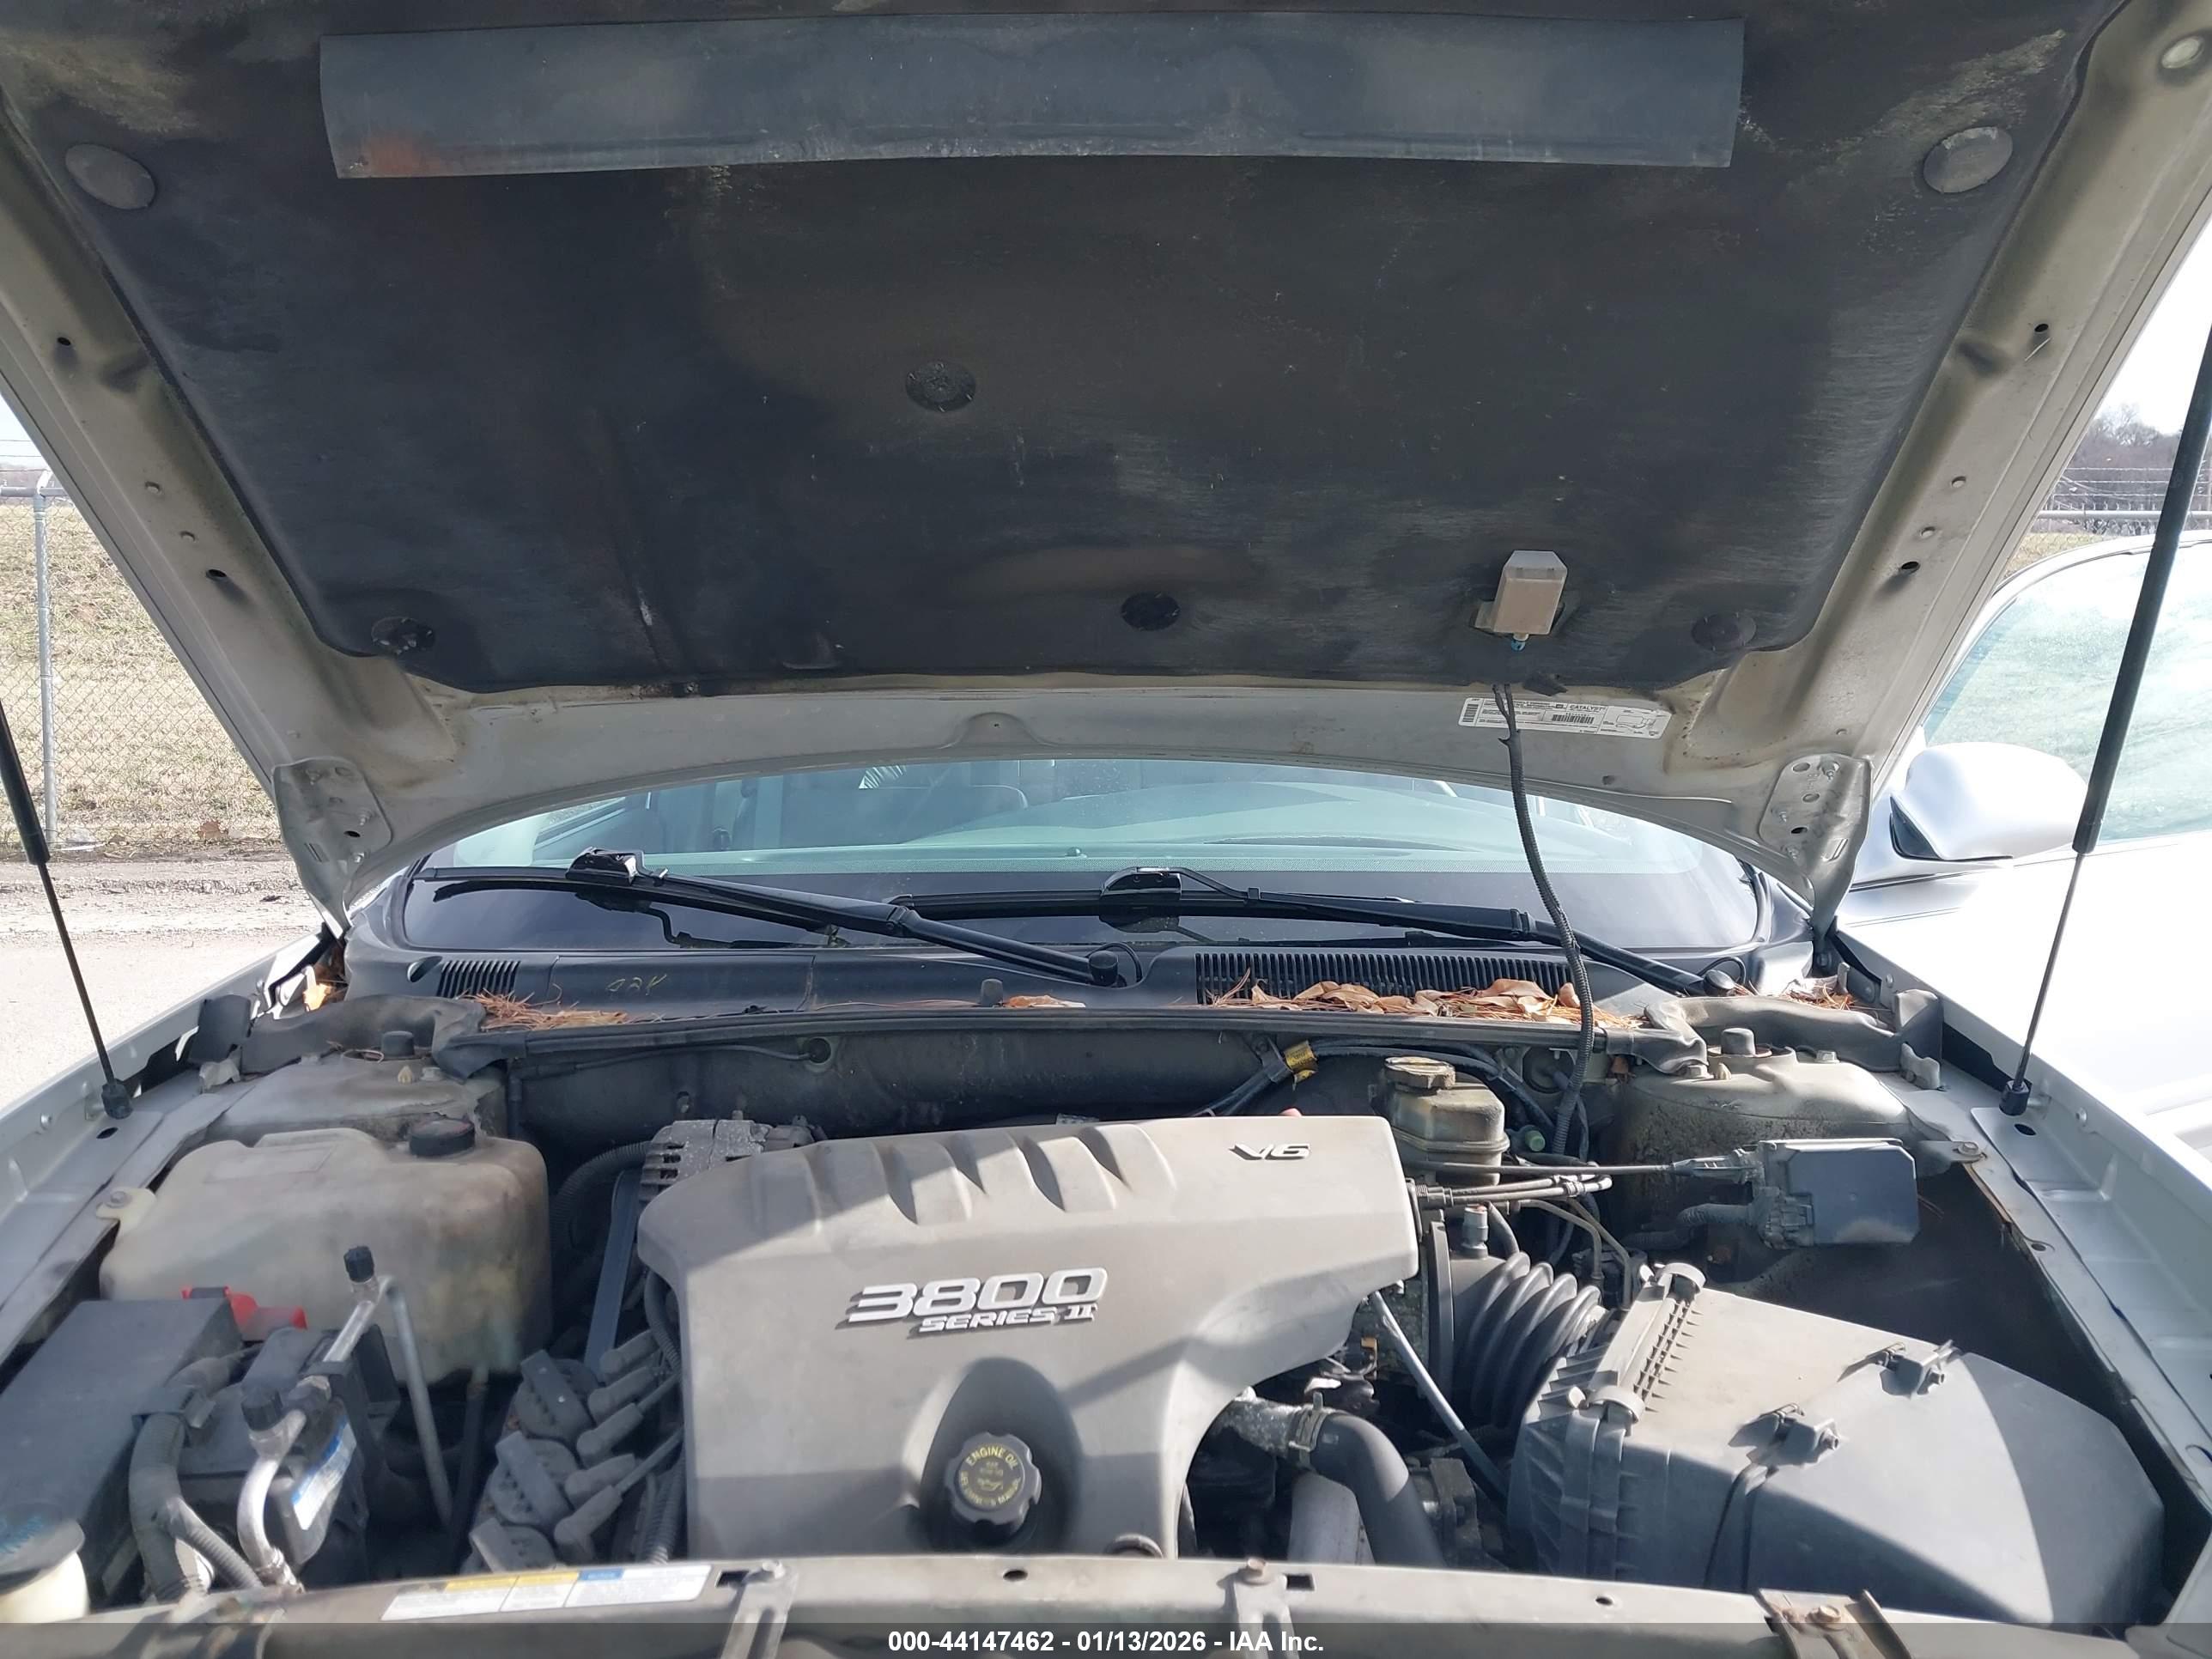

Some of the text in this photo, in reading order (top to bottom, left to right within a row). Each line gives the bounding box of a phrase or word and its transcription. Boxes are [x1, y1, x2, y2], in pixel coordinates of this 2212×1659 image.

[1569, 703, 1603, 713] CATALYST
[1231, 1143, 1310, 1160] V6
[847, 1267, 1108, 1323] 3800
[918, 1306, 1058, 1333] SERIES
[965, 1445, 1006, 1467] ENGINE
